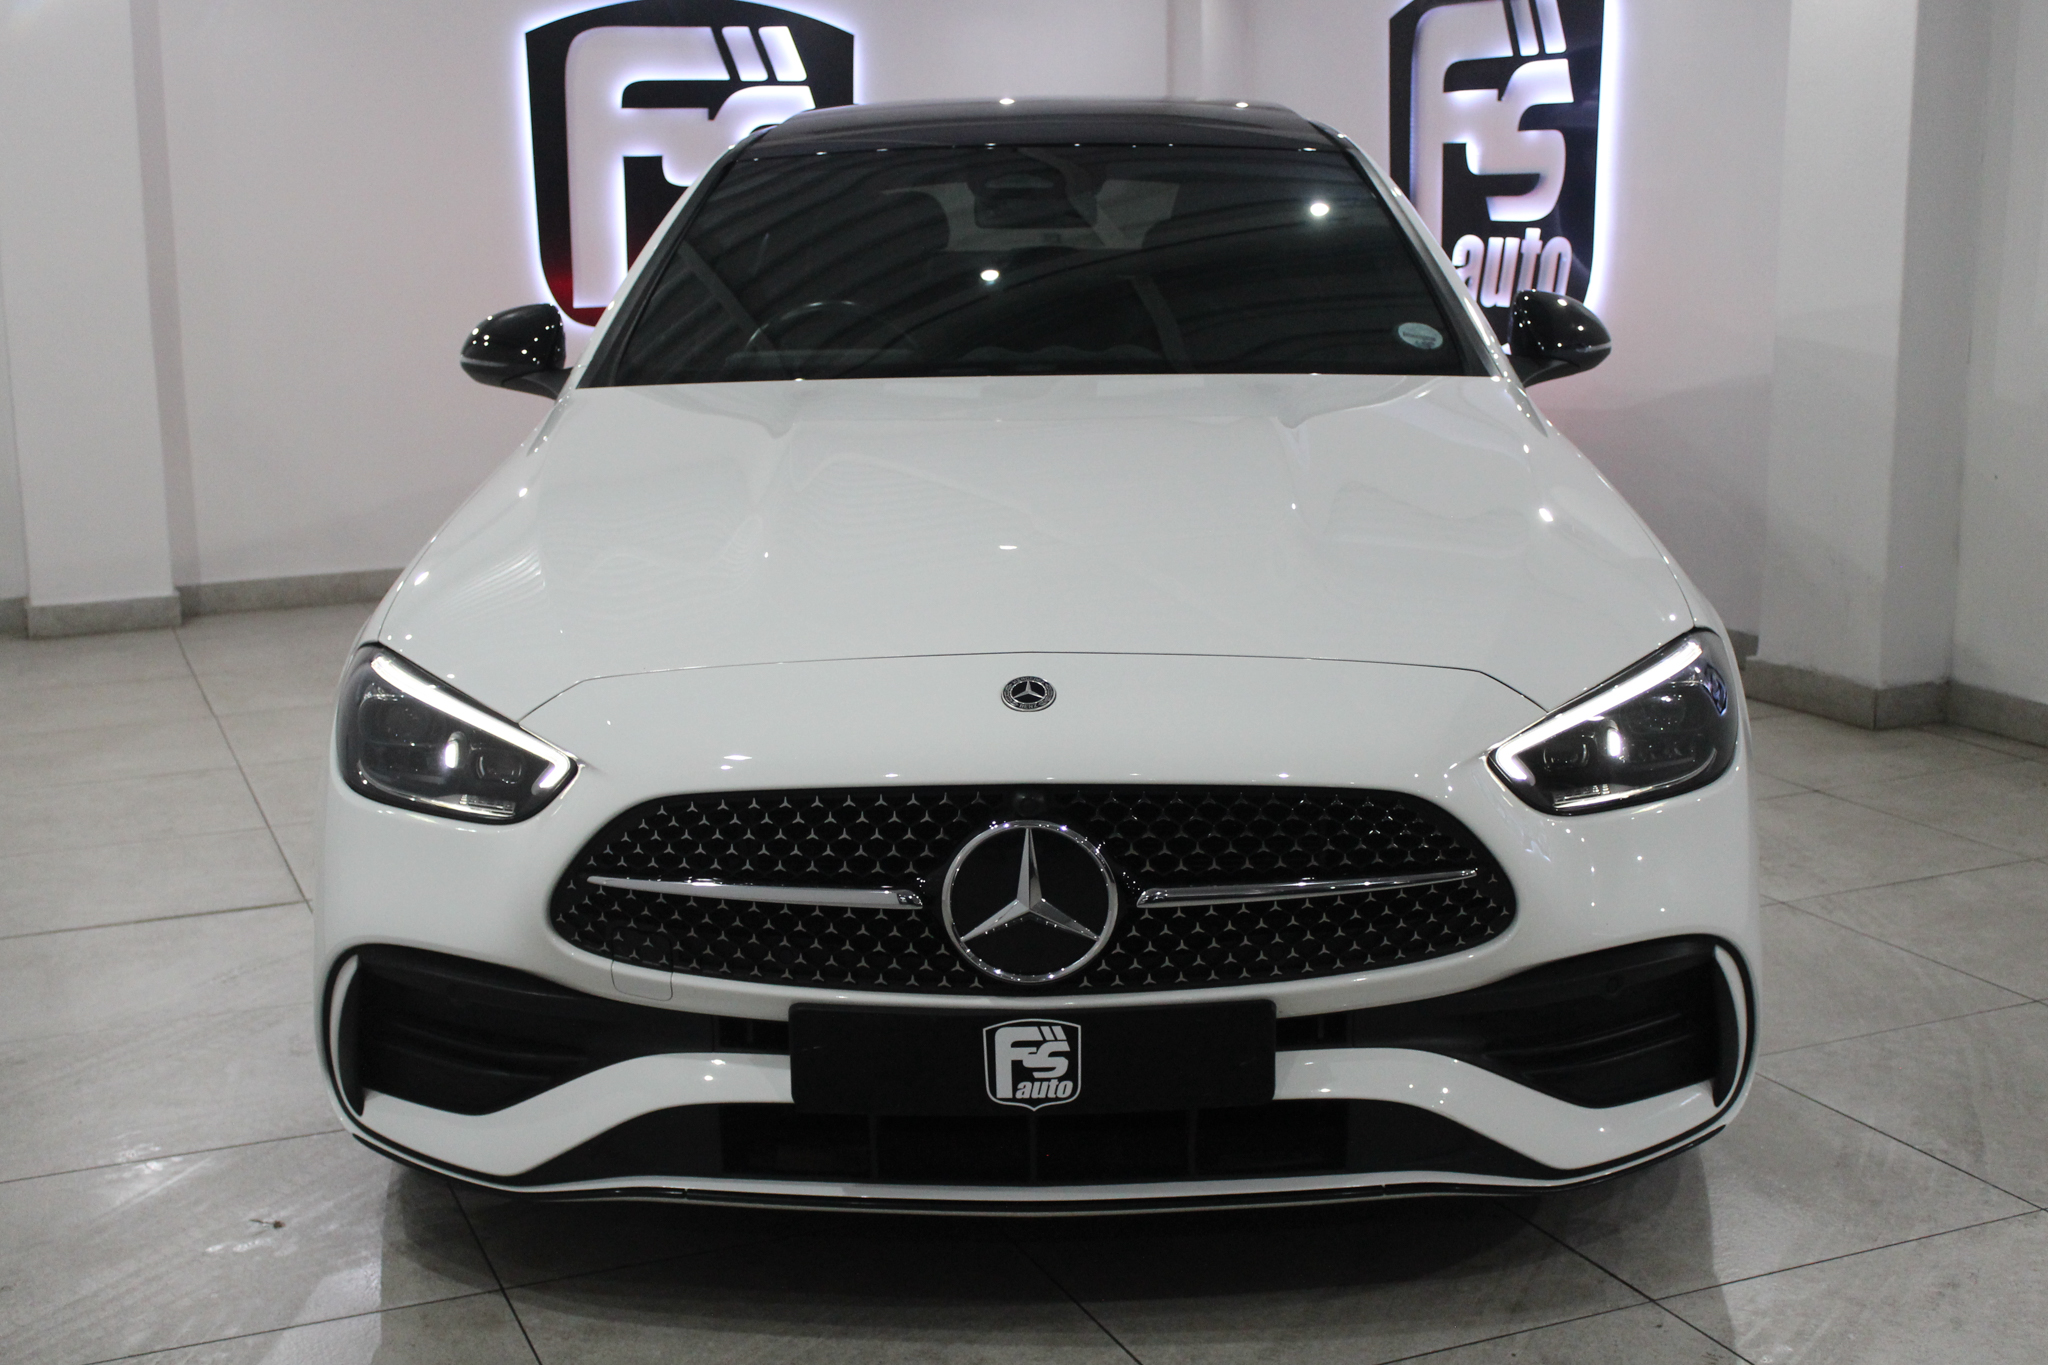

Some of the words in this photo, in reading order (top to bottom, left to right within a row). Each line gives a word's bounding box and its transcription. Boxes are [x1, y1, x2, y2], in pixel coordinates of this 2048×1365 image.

[1409, 0, 1574, 247] FS
[1452, 227, 1573, 308] auto
[995, 1026, 1071, 1099] FS
[1015, 1079, 1074, 1099] auto
